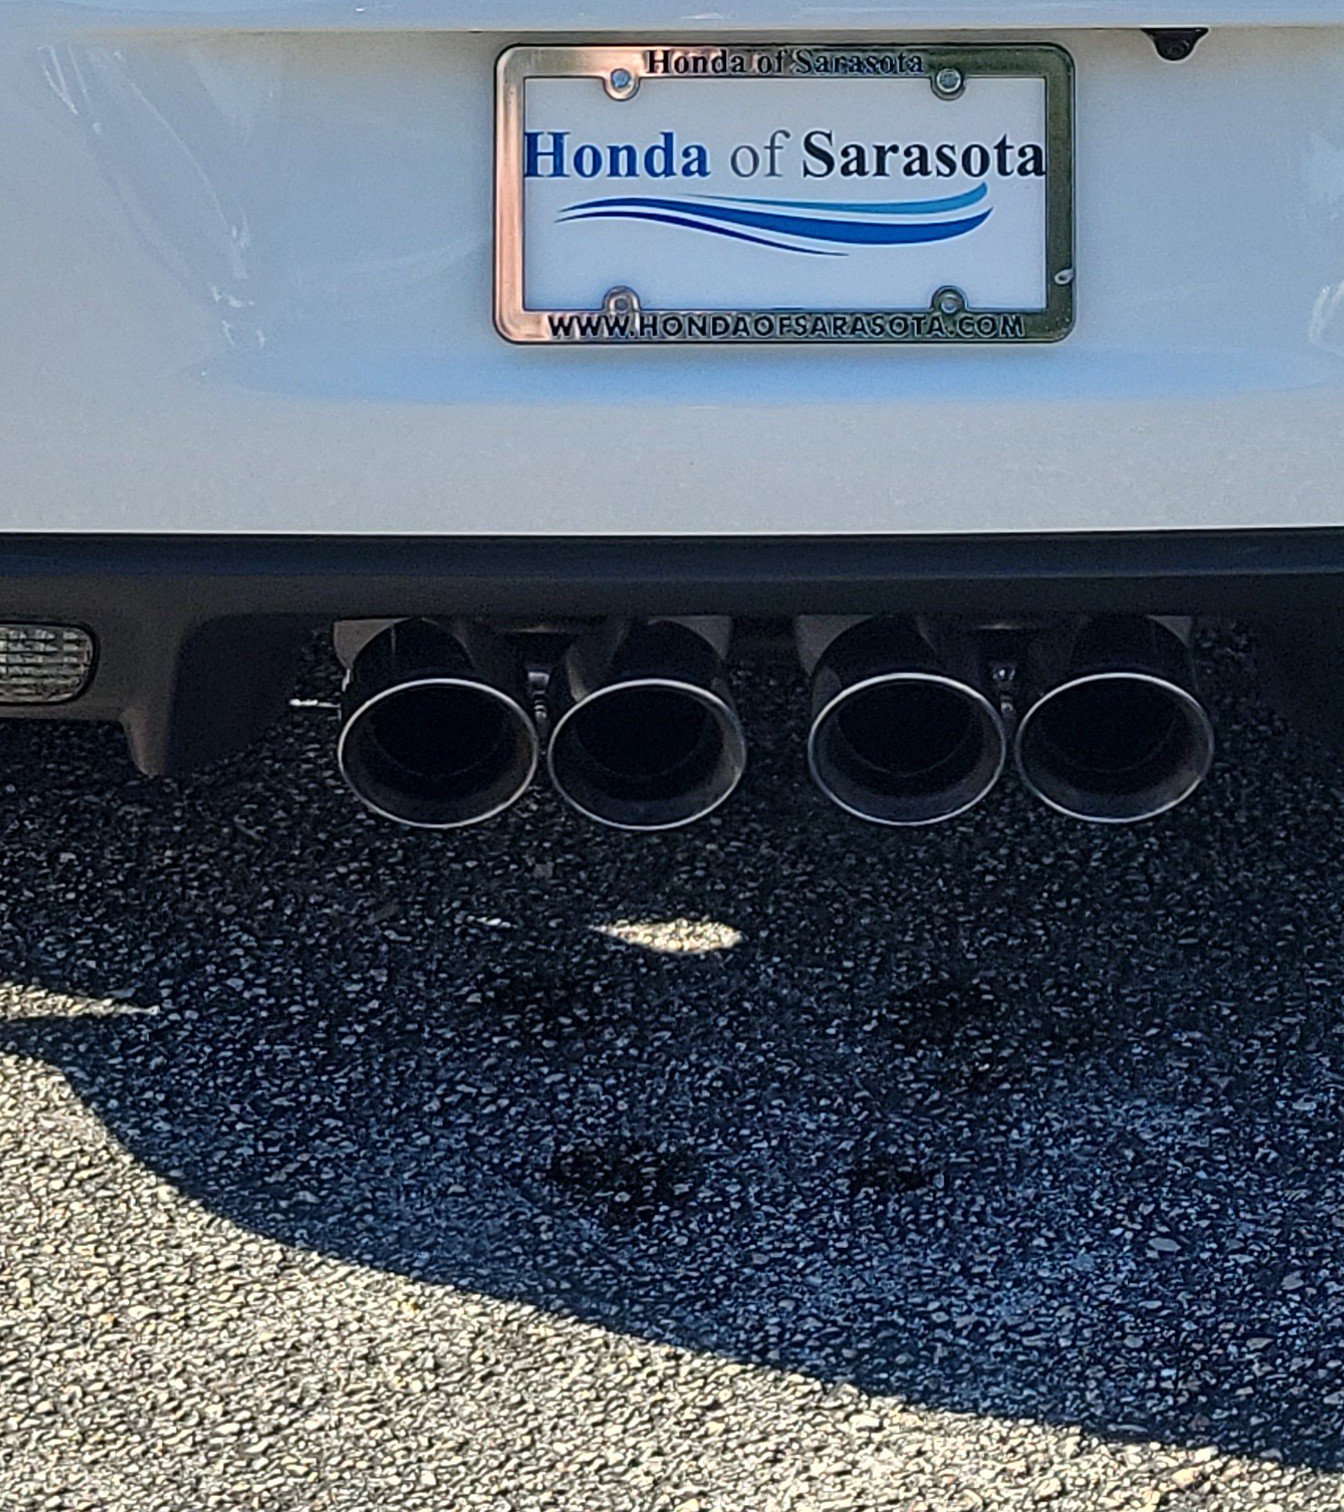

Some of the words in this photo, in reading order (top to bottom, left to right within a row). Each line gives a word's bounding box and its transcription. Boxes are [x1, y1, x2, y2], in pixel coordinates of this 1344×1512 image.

[645, 49, 746, 74] Honda
[756, 50, 786, 74] of
[793, 49, 925, 74] Sarasota
[523, 131, 711, 178] Honda
[729, 129, 792, 178] of
[802, 129, 1047, 178] Sarasota
[547, 313, 1025, 339] WWW.HONDAOFSARASOTA.COM
